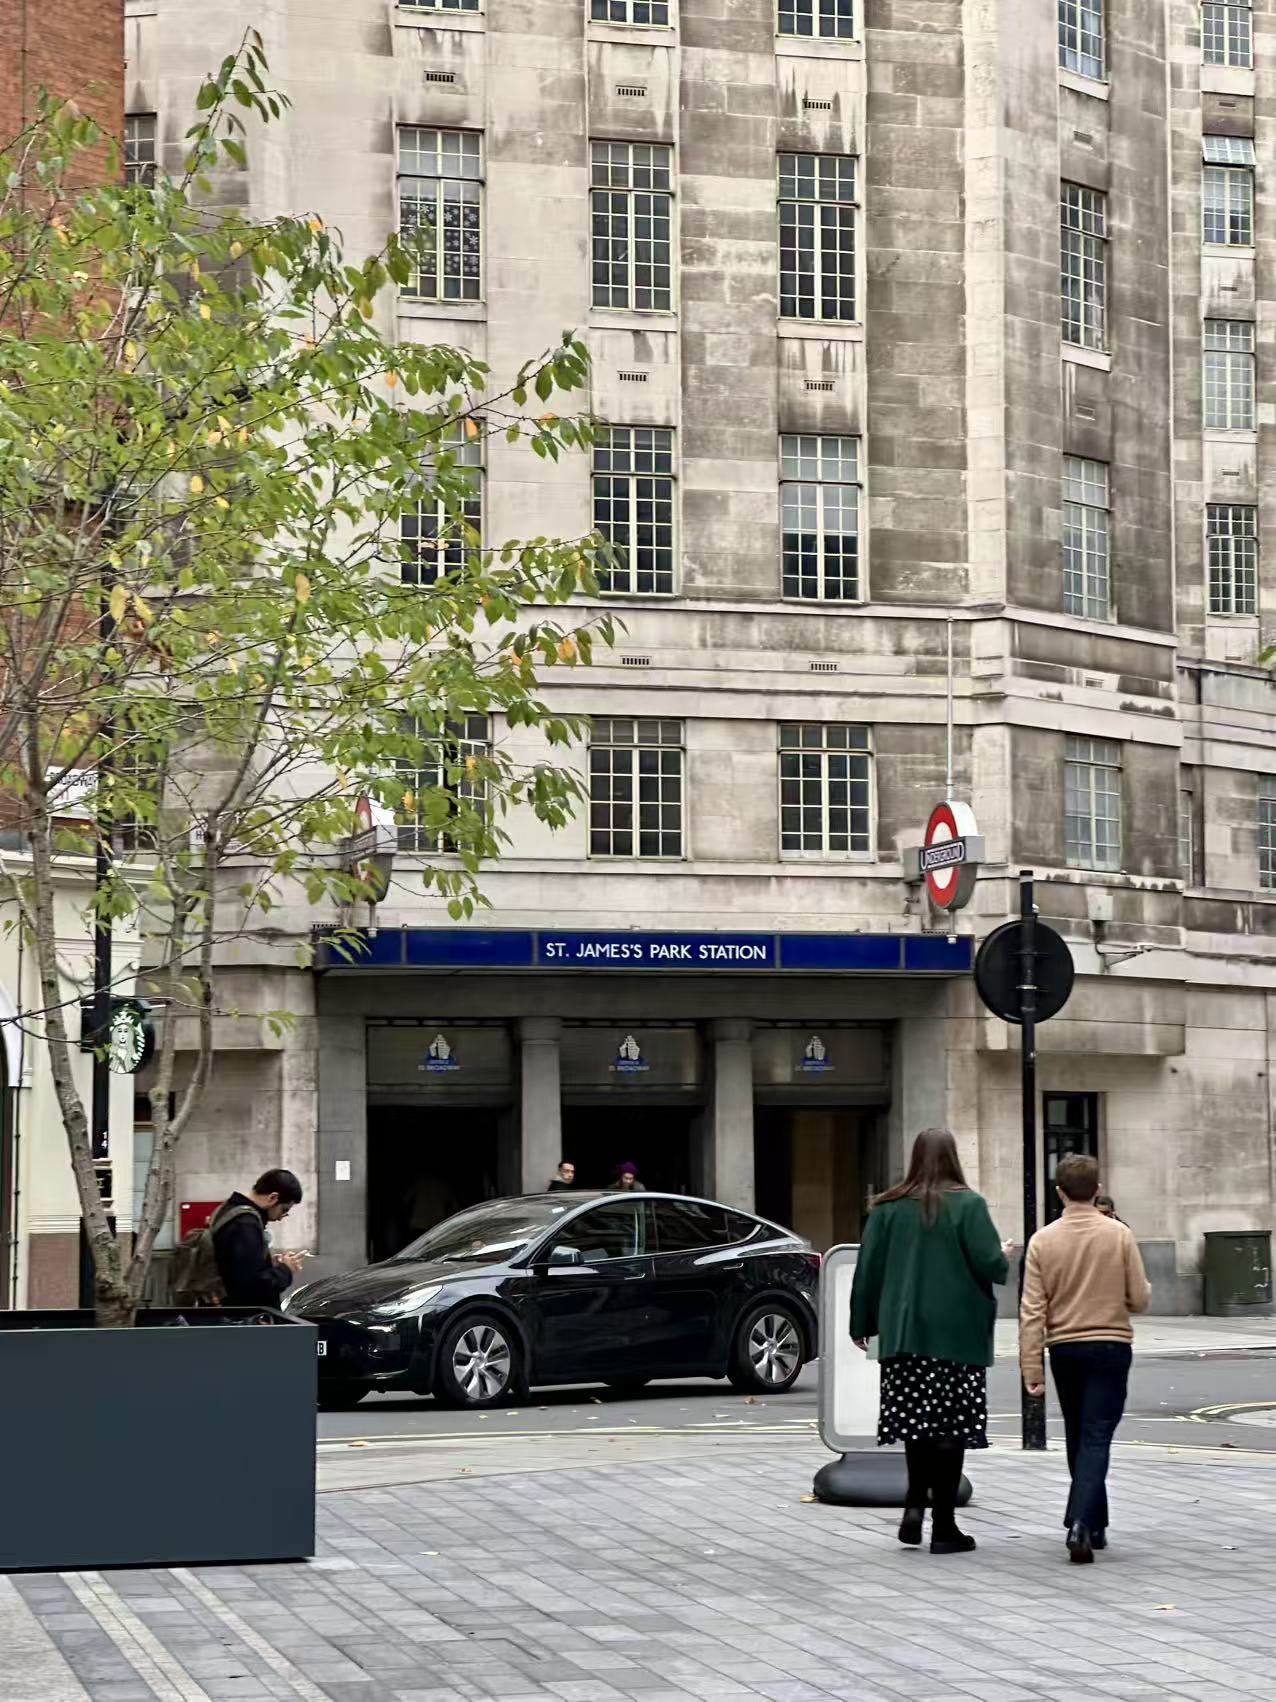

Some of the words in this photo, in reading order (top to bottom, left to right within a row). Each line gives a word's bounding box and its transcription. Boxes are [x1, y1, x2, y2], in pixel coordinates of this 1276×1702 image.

[920, 842, 964, 869] UNDERGROUND
[546, 942, 569, 958] ST.
[576, 943, 643, 958] JAMES'S
[650, 945, 692, 959] PARK
[699, 945, 766, 959] STATION
